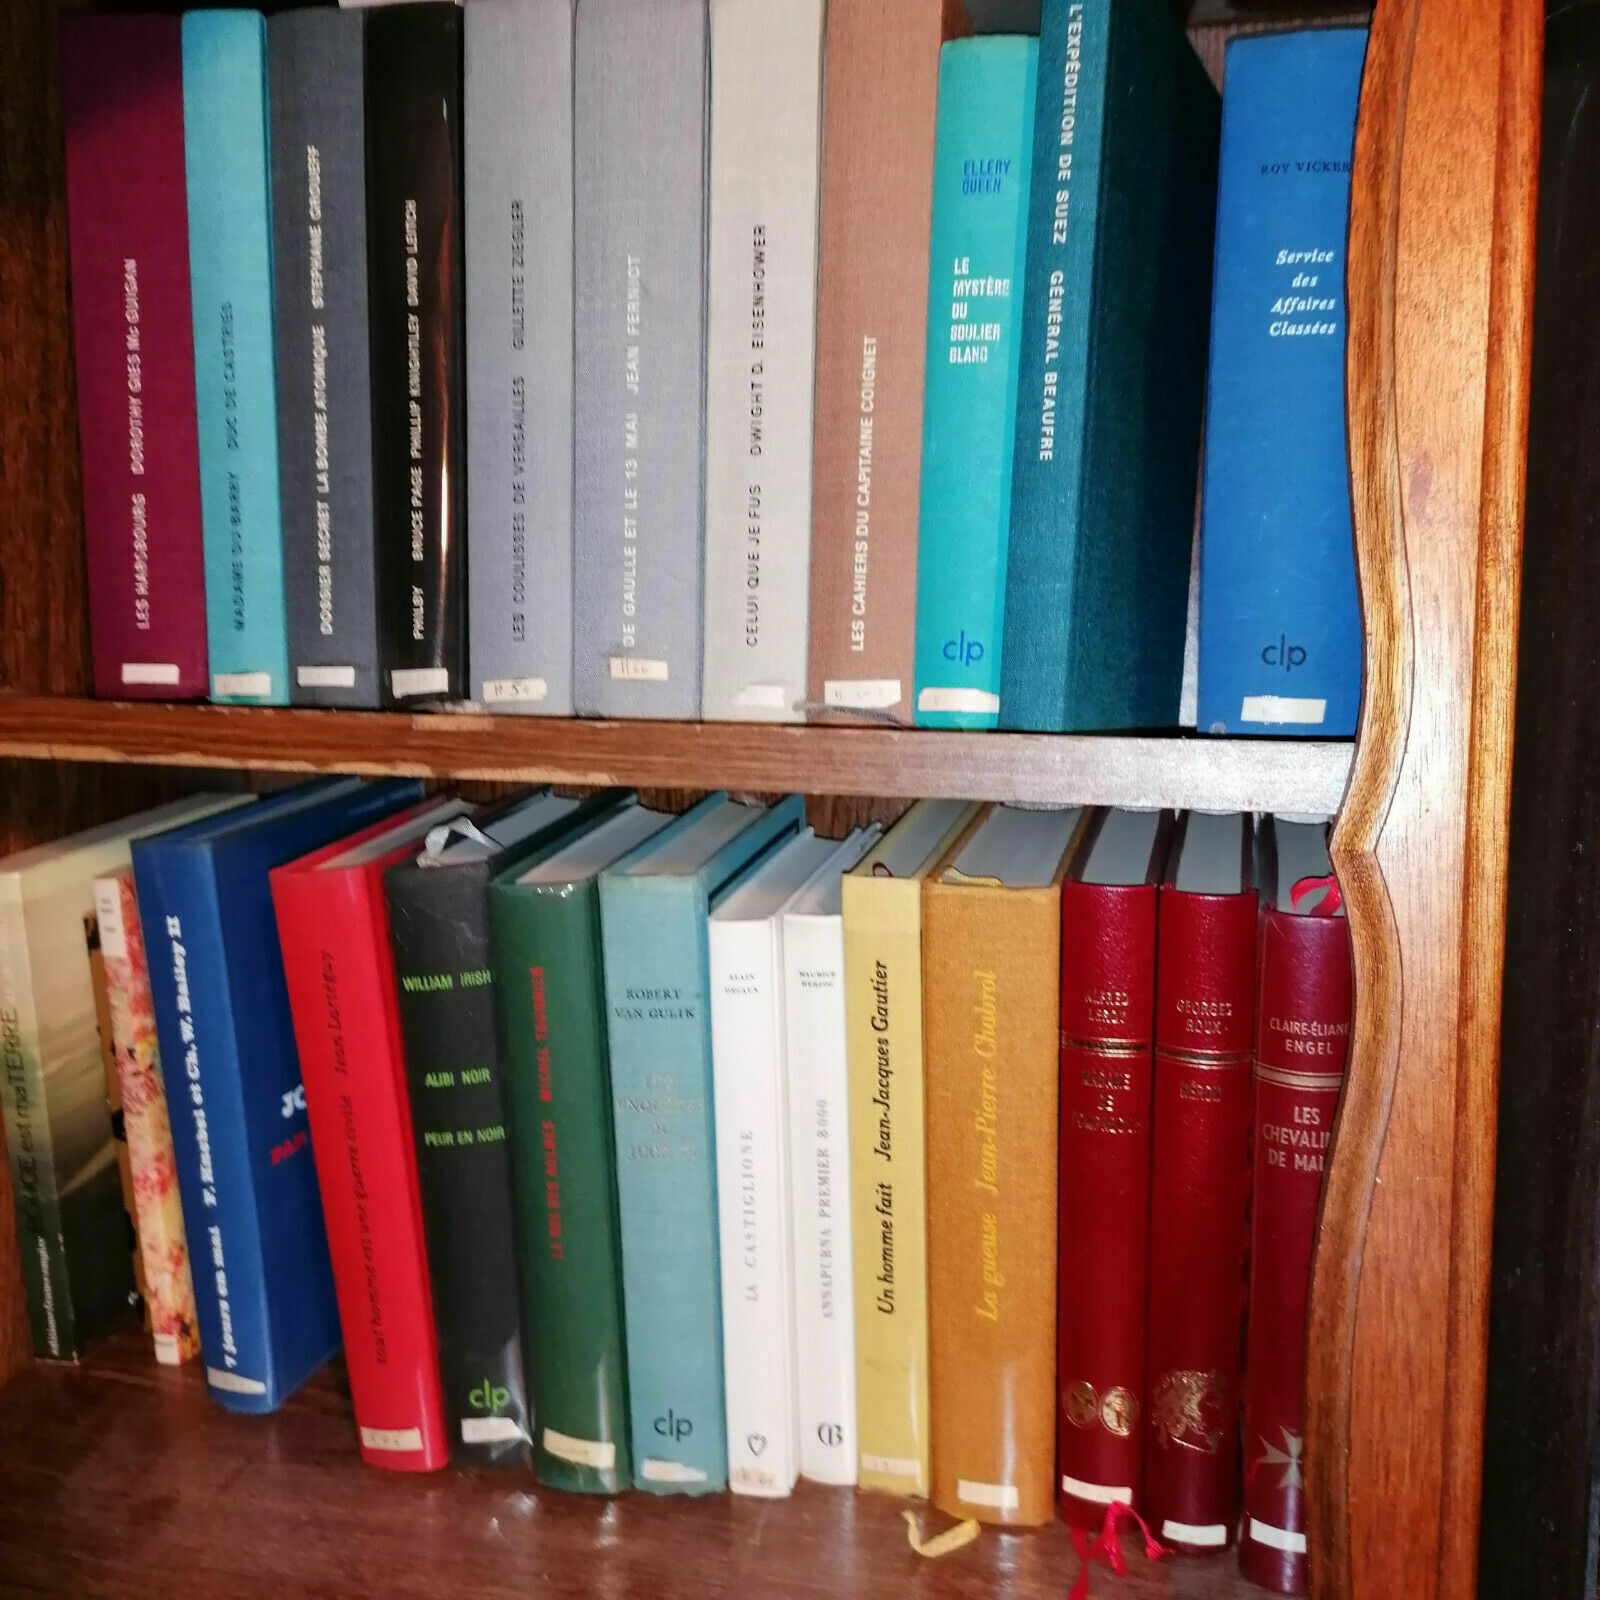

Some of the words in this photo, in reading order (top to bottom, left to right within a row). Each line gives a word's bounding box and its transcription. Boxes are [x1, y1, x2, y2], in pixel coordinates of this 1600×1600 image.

[1060, 3, 1083, 145] L'EXPÉDITION
[963, 160, 1011, 174] ELLERY
[1058, 154, 1072, 181] DE
[1261, 163, 1290, 175] ROY
[962, 179, 1001, 195] QUEEN
[511, 200, 524, 269] ZIEGLER
[1053, 190, 1069, 244] SUEZ
[954, 257, 969, 275] LE
[1276, 249, 1334, 265] Service
[406, 258, 419, 306] DAVID
[626, 255, 640, 336] FERNIOT
[751, 224, 766, 350] EISENHOWER
[953, 277, 1010, 298] MYSTÈRE
[1292, 273, 1318, 288] des
[1045, 270, 1064, 363] GÉNÉRAL
[1270, 297, 1335, 315] Affaires
[126, 326, 140, 350] Mc
[950, 324, 1000, 342] SOULIER
[1270, 320, 1336, 337] Classées
[312, 325, 327, 410] ATOMIQUE
[626, 347, 639, 395] JEAN
[950, 346, 987, 364] BLANC
[861, 335, 876, 412] COIGNET
[225, 388, 237, 408] DE
[512, 376, 524, 476] VERSAILLES
[625, 413, 638, 449] MAI
[750, 381, 763, 457] DWIGHT
[1039, 372, 1056, 461] BEAUFRE
[129, 396, 145, 475] DOROTHY
[314, 412, 328, 468] BOMBE
[625, 459, 637, 480] 13
[857, 417, 873, 506] CAPITAINE
[410, 467, 422, 507] PAGE
[512, 483, 524, 504] DE
[625, 488, 637, 509] LE
[748, 485, 761, 520] FUS
[316, 501, 331, 561] SECRET
[411, 511, 423, 561] BRUCE
[625, 517, 637, 539] ET
[748, 526, 760, 545] JE
[512, 512, 525, 605] COULISSES
[747, 552, 760, 588] QUE
[622, 546, 637, 615] GAULLE
[853, 542, 867, 616] CAHIERS
[135, 599, 149, 629] LES
[318, 565, 332, 634] DOSSIER
[411, 586, 424, 640] PHILBY
[512, 612, 525, 642] LES
[622, 624, 636, 647] DE
[746, 595, 758, 647] CELUI
[851, 620, 865, 651] LES
[943, 630, 984, 667] clp
[1261, 634, 1306, 671] clp
[318, 950, 343, 1031] Lartéguy
[403, 974, 453, 992] WILLIAM
[460, 969, 492, 988] IRISH
[625, 988, 681, 1000] ROBERT
[870, 960, 889, 1032] Gautier
[614, 1008, 642, 1018] VAN
[649, 1007, 696, 1019] GULIK
[973, 969, 997, 1058] Chabrol
[332, 1035, 348, 1077] Jean
[1285, 1039, 1333, 1055] ENGEL
[191, 1081, 203, 1104] et
[461, 1067, 492, 1085] NOIR
[872, 1037, 893, 1162] Jean-Jacques
[1294, 1106, 1320, 1125] LES
[340, 1095, 358, 1141] civile
[456, 1130, 473, 1145] EN
[476, 1126, 505, 1143] NOIR
[973, 1069, 998, 1195] Jean-Pierre
[347, 1144, 369, 1200] guerre
[1268, 1150, 1286, 1167] DE
[818, 1148, 831, 1218] PREMIER
[875, 1183, 893, 1217] fait
[358, 1203, 371, 1235] une
[208, 1226, 225, 1268] mai
[553, 1241, 564, 1259] LE
[877, 1220, 894, 1284] homme
[983, 1213, 1006, 1286] gueuse
[215, 1271, 227, 1296] en
[364, 1266, 384, 1326] homme
[878, 1289, 894, 1314] Un
[976, 1291, 998, 1321] La
[218, 1300, 237, 1354] jours
[224, 1355, 237, 1368] 7
[469, 1378, 510, 1412] clp
[655, 1409, 693, 1442] clp
